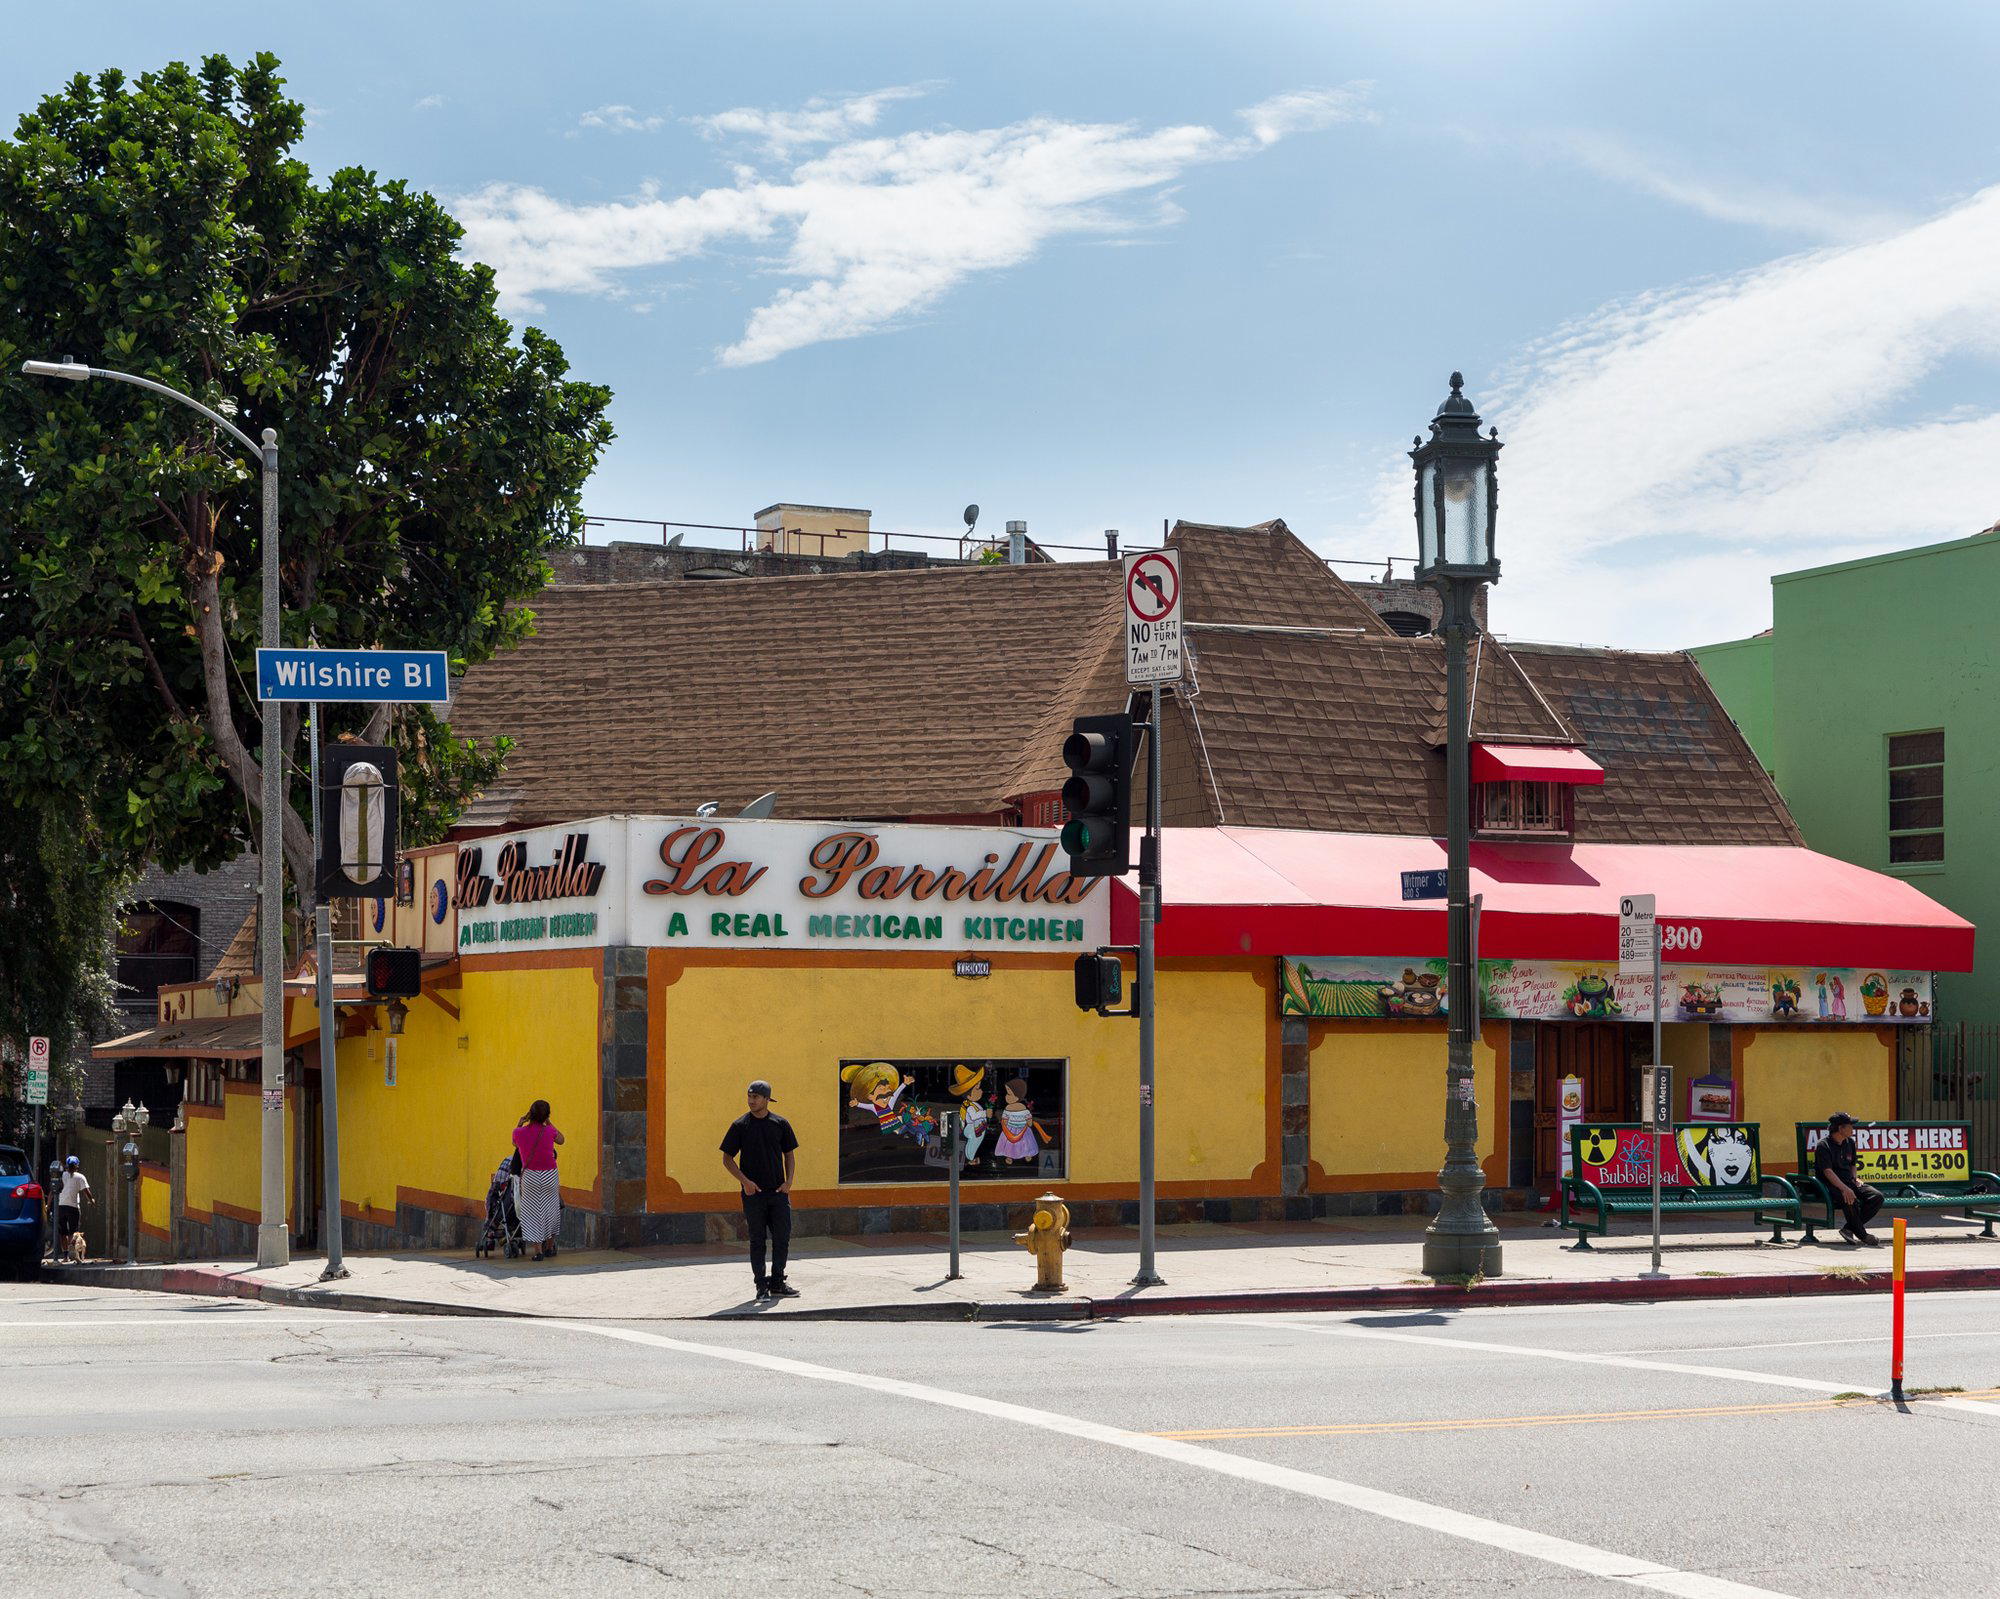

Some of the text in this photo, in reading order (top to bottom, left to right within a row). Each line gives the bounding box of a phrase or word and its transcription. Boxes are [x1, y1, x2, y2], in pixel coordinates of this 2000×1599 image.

[1131, 621, 1177, 644] NO LEFT
[1154, 631, 1177, 641] TURN
[1131, 647, 1149, 664] 7AM
[1150, 649, 1158, 659] TO
[275, 660, 432, 688] Wilshire Bl
[451, 833, 606, 910] La Parrilla
[643, 827, 1106, 904] La Parrilla
[1403, 871, 1447, 889] Witmer St
[1415, 887, 1420, 898] S
[1634, 912, 1653, 920] Metro
[459, 911, 598, 948] A REAL MEXICAN KITCHEN
[667, 912, 1084, 942] A REAL MEXICAN KITCHEN
[1621, 926, 1632, 937] 20
[1621, 938, 1634, 949] 487
[1661, 925, 1703, 950] 300
[1620, 950, 1635, 960] 489
[1511, 966, 1536, 983] Your
[1613, 973, 1636, 986] Fresh
[1489, 979, 1559, 997] Dining Pleasure
[1533, 990, 1556, 1003] Made
[1616, 986, 1636, 1001] Made
[29, 1072, 36, 1080] 2
[1658, 1076, 1667, 1122] Go Metro
[1915, 1128, 1963, 1149] HERE
[1044, 1155, 1055, 1169] A
[1599, 1164, 1680, 1185] Bubblehad
